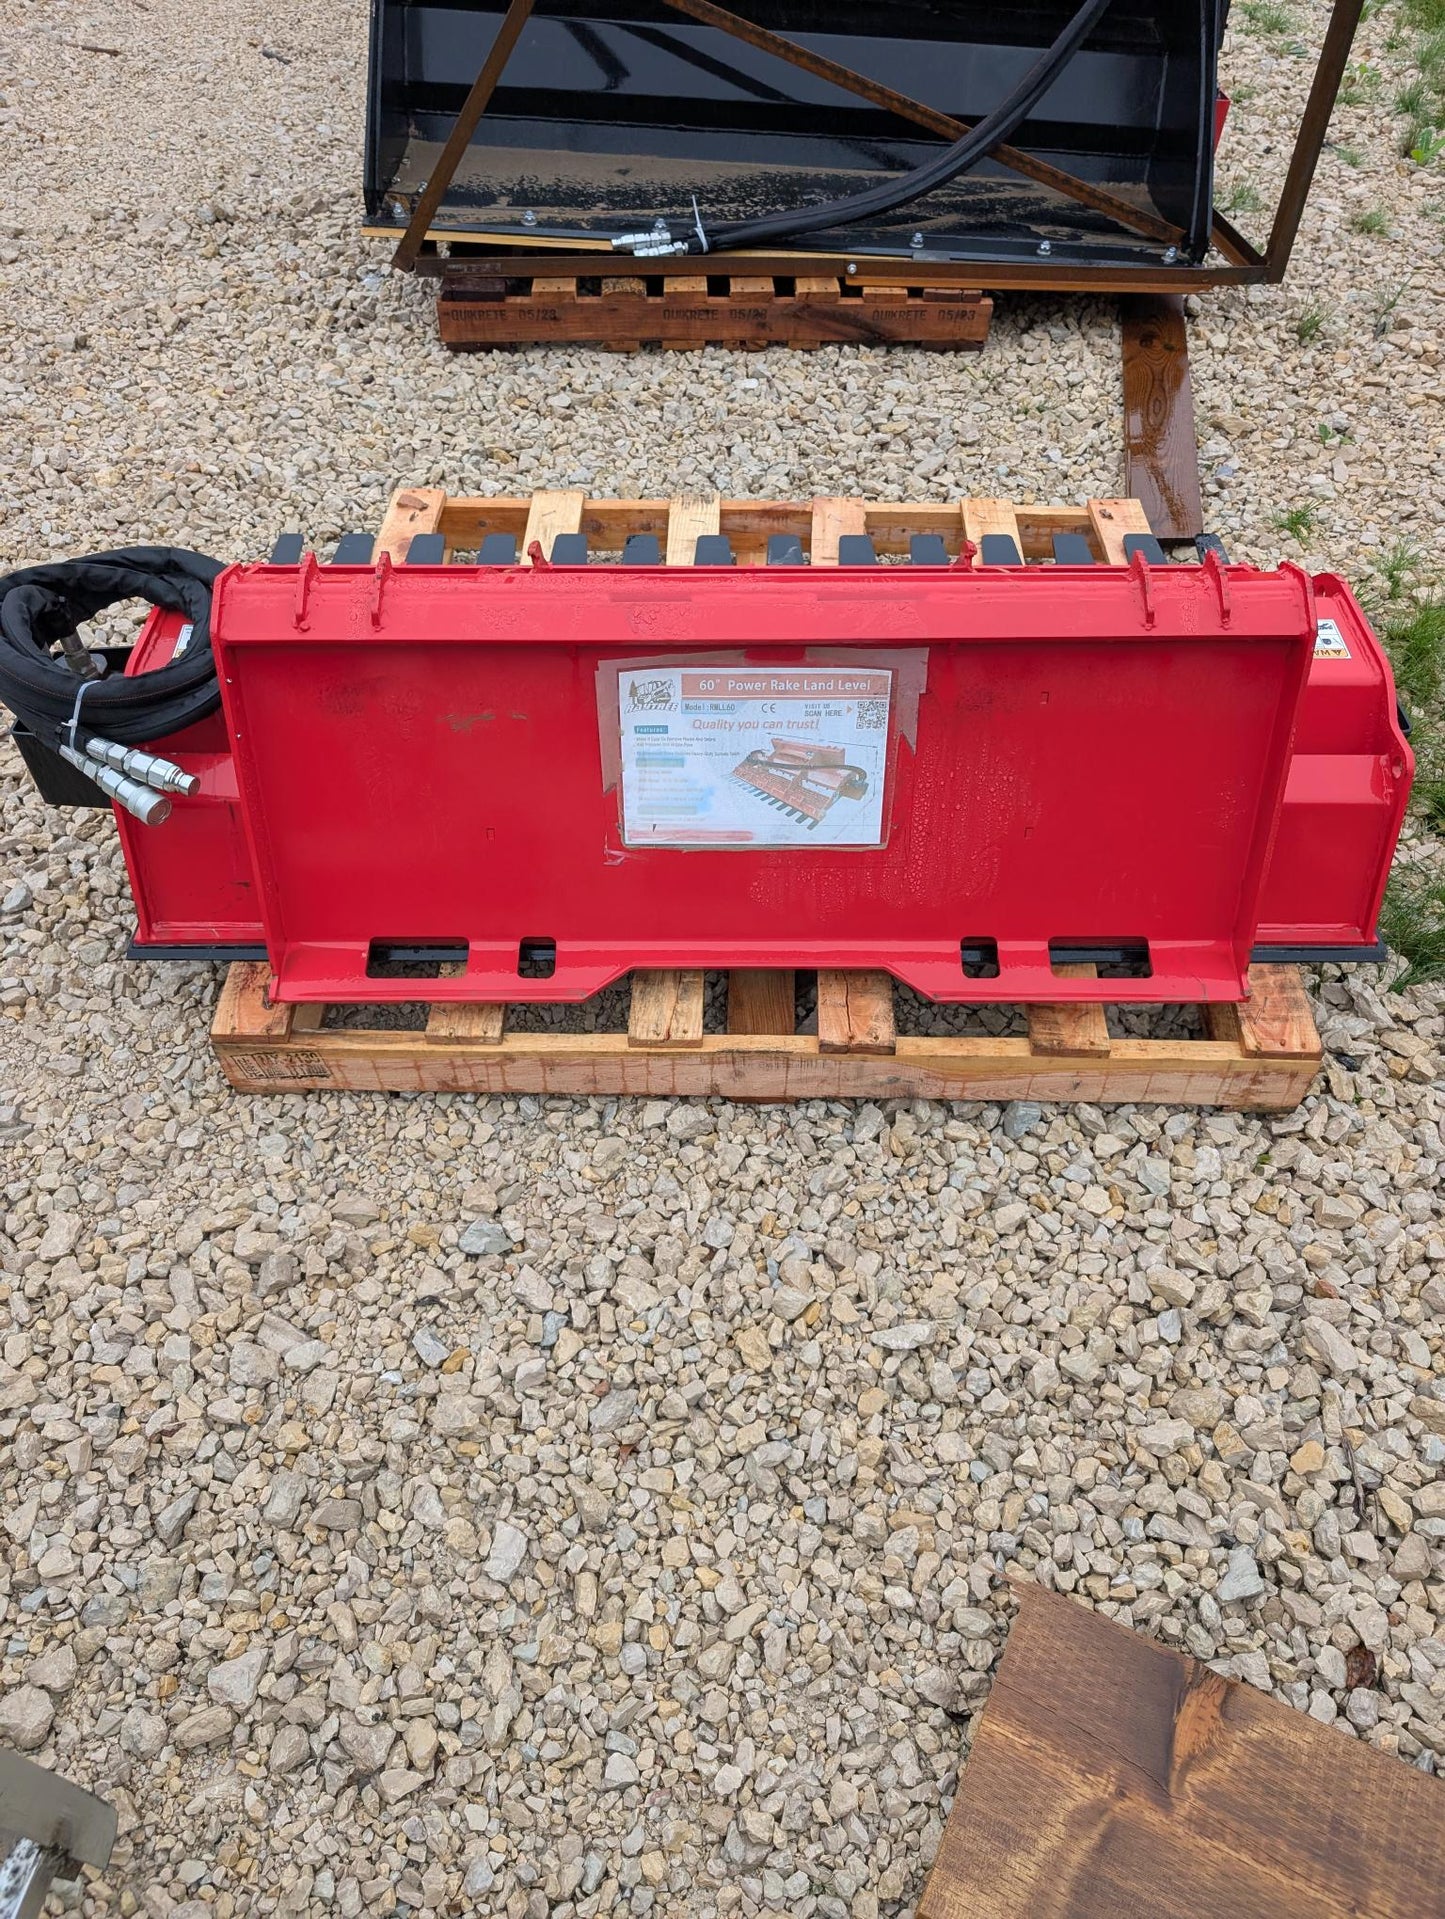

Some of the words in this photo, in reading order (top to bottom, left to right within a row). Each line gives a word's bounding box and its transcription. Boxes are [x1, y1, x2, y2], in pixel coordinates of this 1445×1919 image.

[451, 308, 507, 321] QUIKRETE
[663, 308, 719, 321] QUIKRETE
[872, 309, 927, 321] QUIKRETE
[728, 679, 766, 692] Power
[770, 679, 800, 691] Rake
[803, 679, 834, 691] Land
[838, 679, 871, 691] Level
[804, 709, 822, 717] SCAN
[825, 709, 843, 717] HERE
[692, 719, 735, 732] Quality
[736, 721, 760, 732] you
[762, 721, 783, 730] can
[786, 719, 820, 730] trust!
